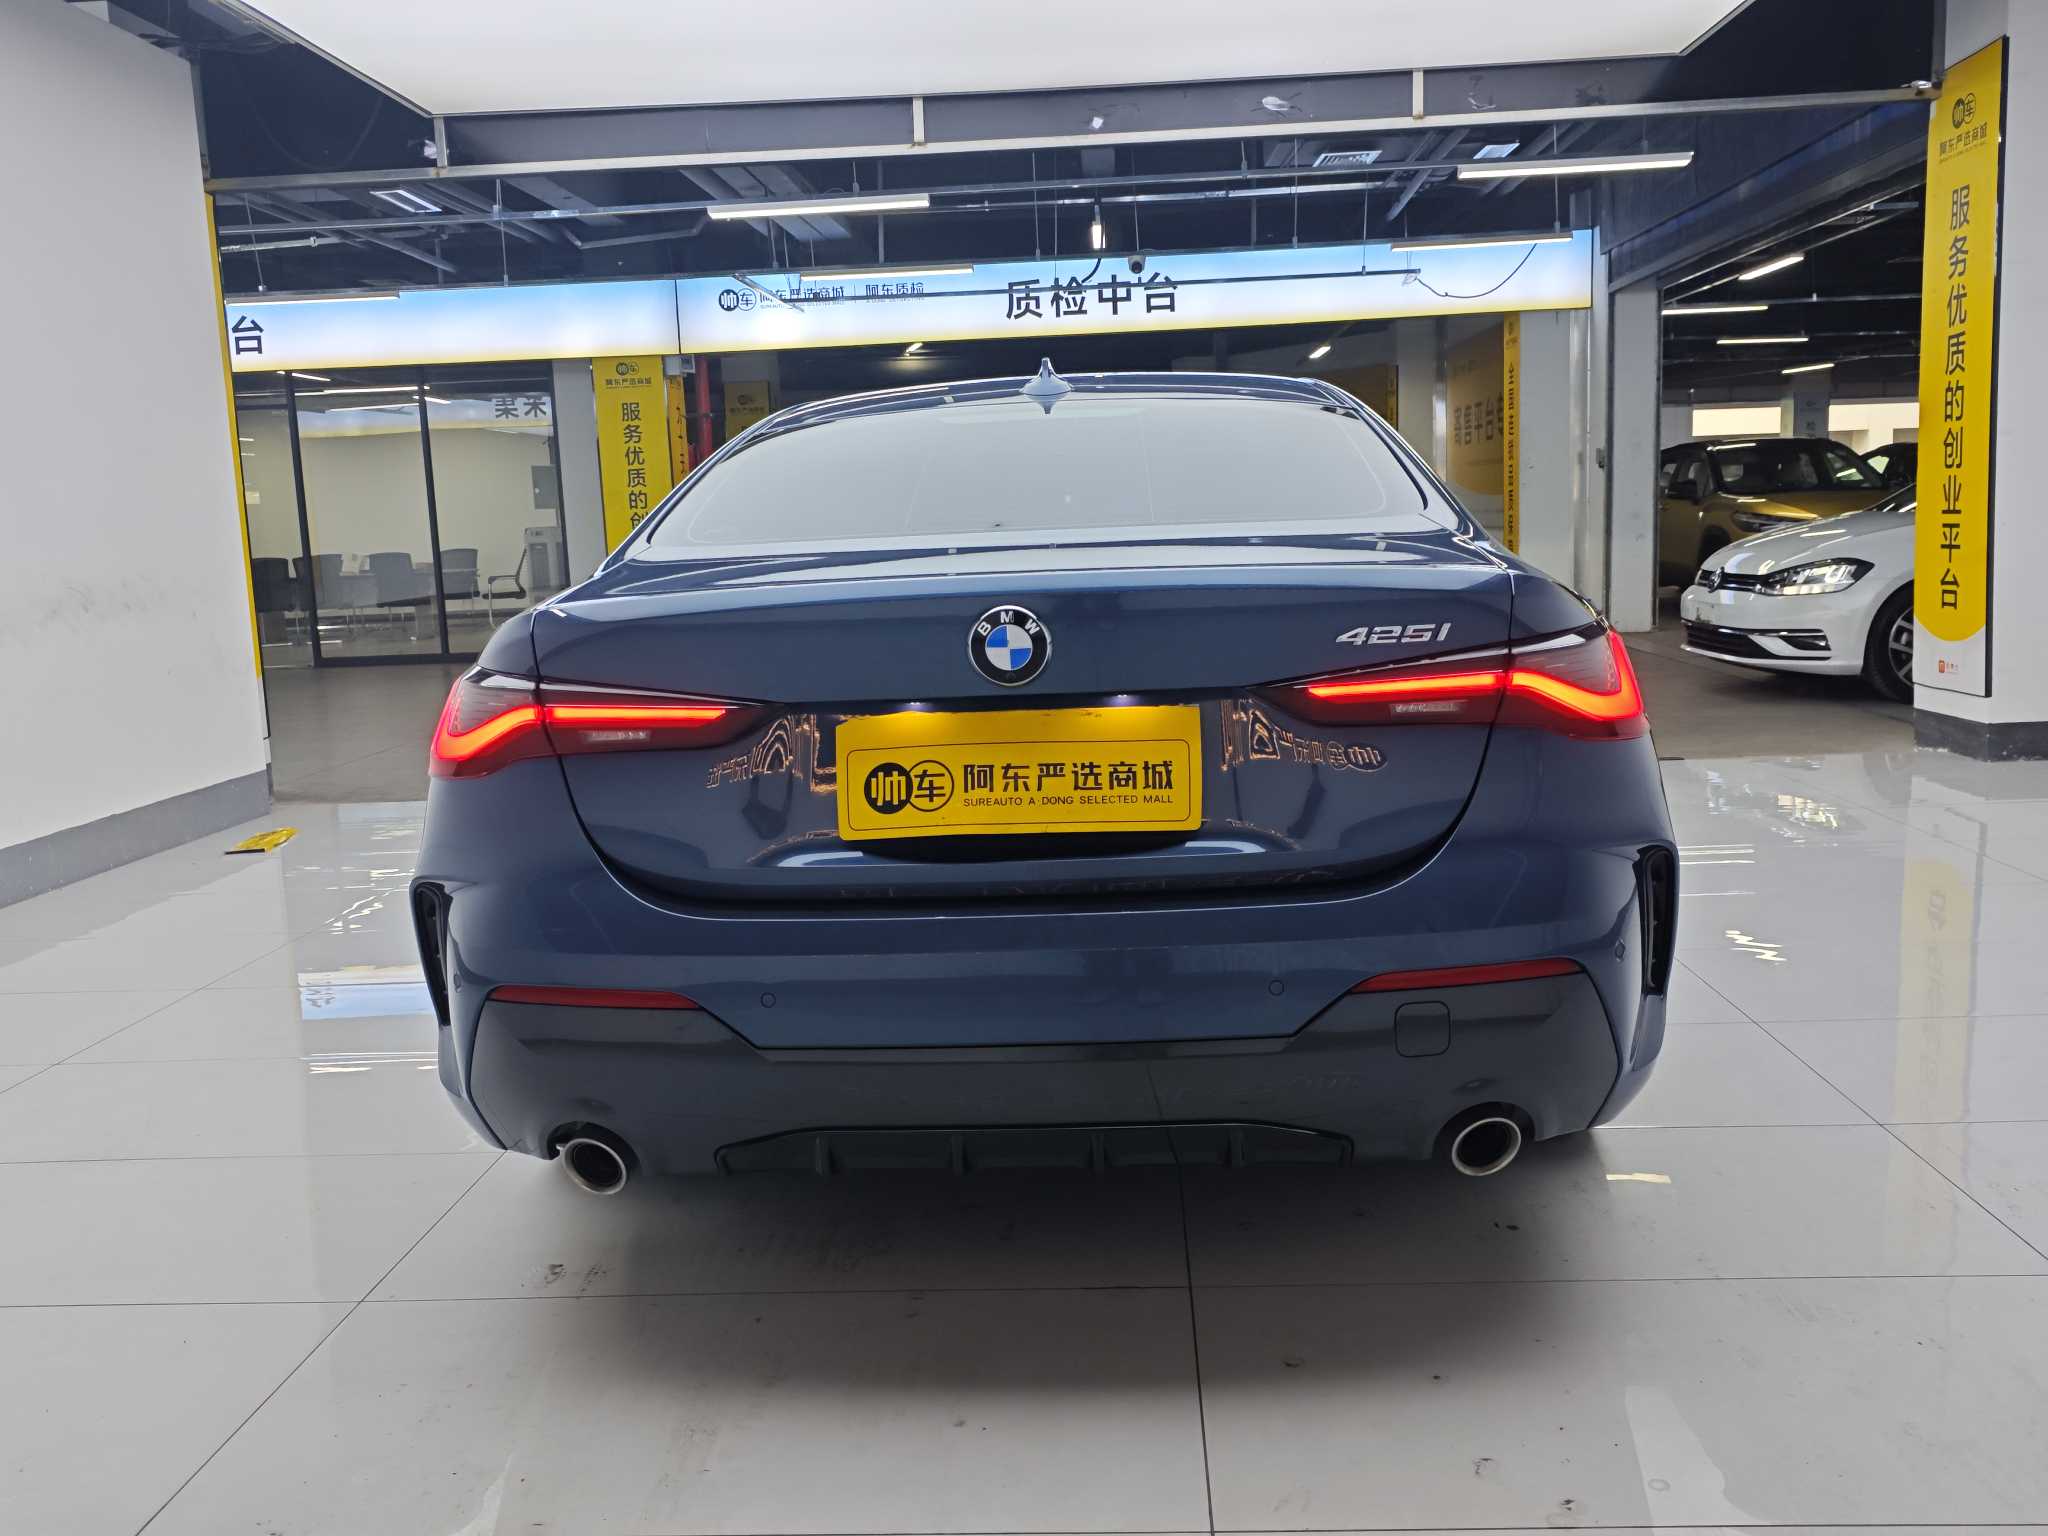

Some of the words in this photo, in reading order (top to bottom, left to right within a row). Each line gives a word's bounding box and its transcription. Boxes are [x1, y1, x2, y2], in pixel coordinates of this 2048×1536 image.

[1006, 272, 1178, 320] 质检中台
[232, 315, 264, 355] 台
[1940, 184, 1970, 610] 服务优质的创业平台
[977, 611, 1041, 636] BMW
[866, 763, 951, 811] 帅车
[963, 760, 1174, 794] 阿东严选商城
[963, 797, 1023, 807] SUREAUTO
[1079, 794, 1138, 804] SELECTED
[1143, 794, 1174, 804] MALL
